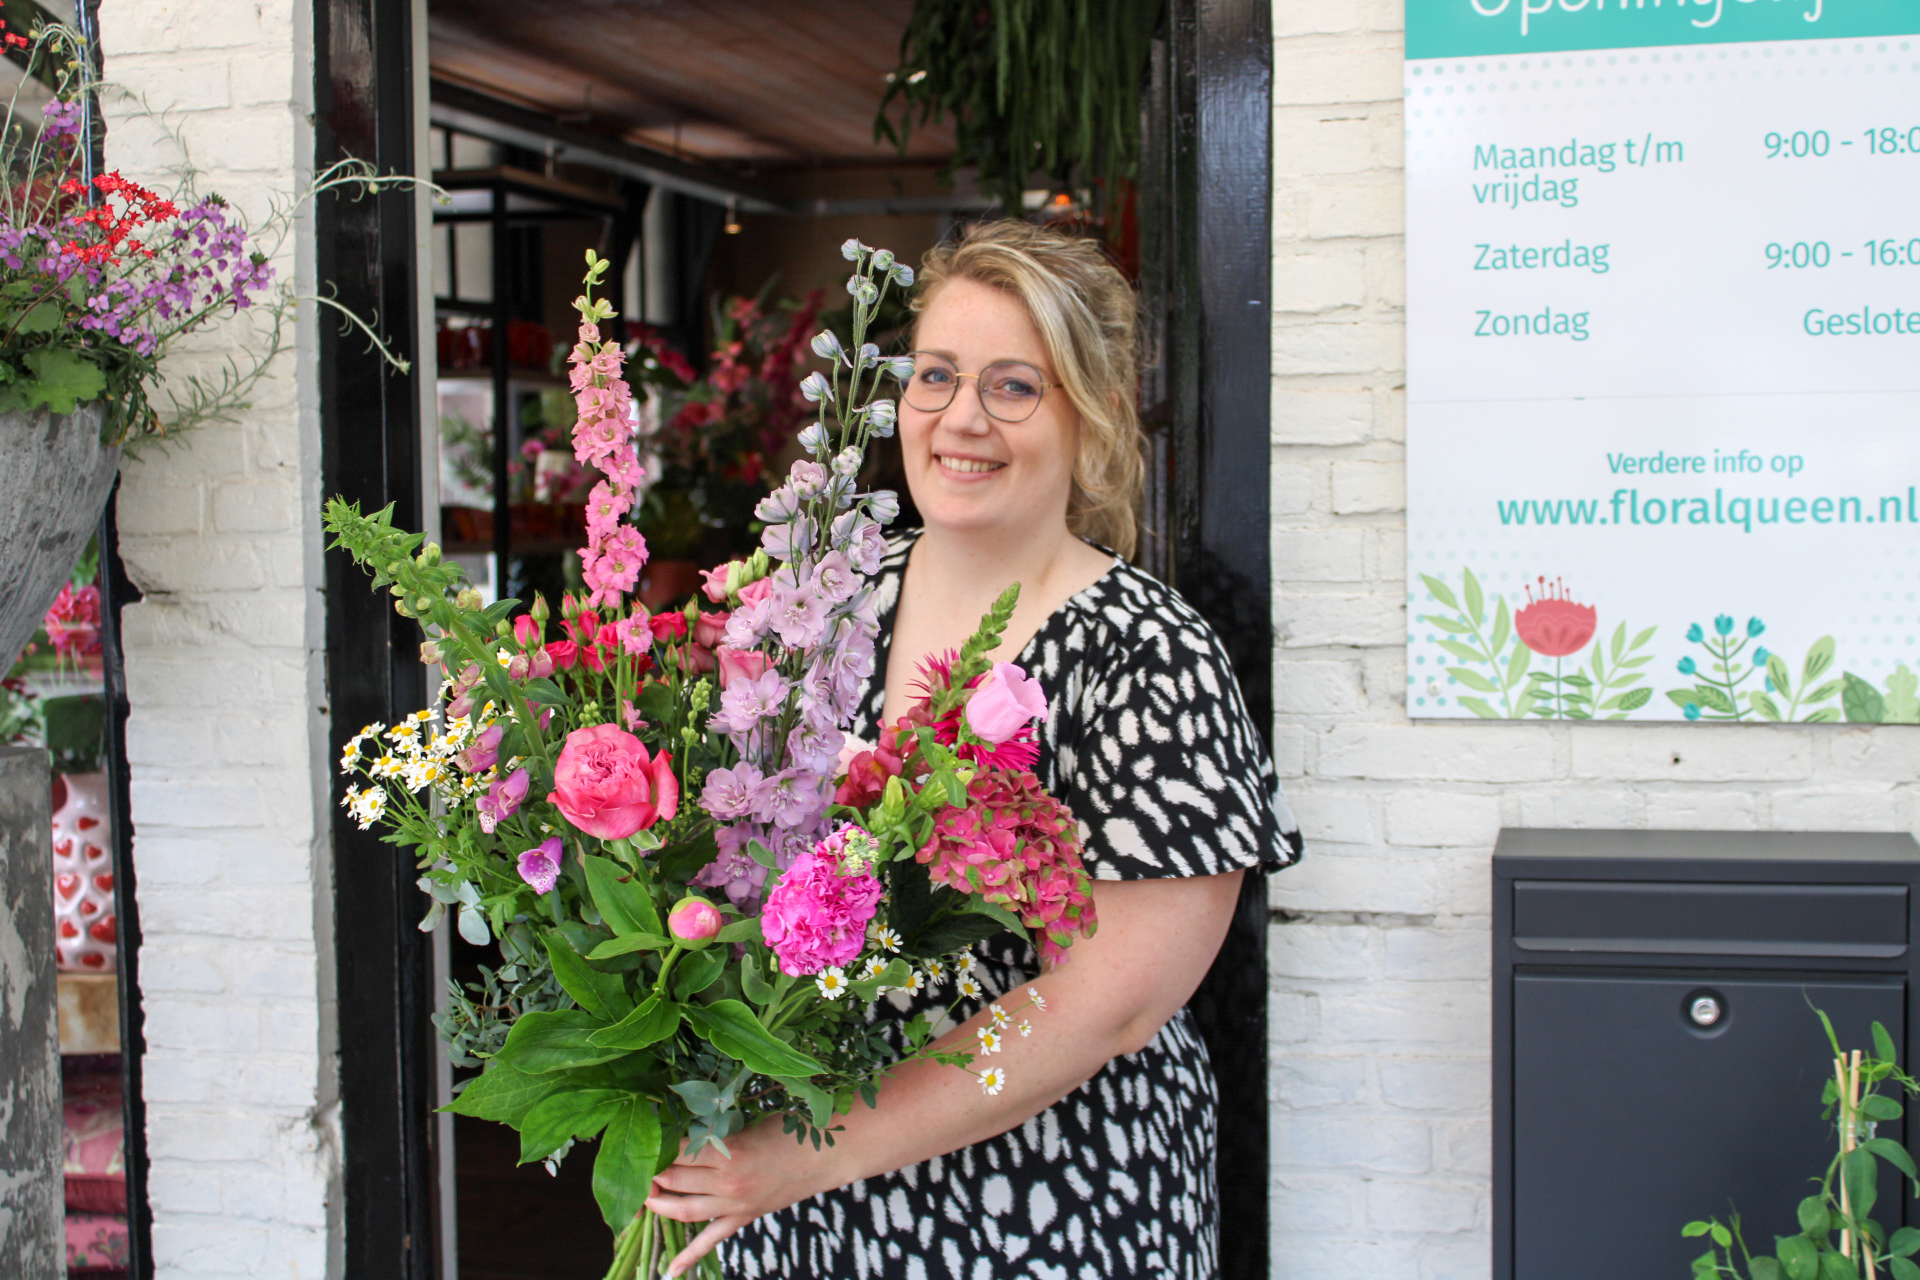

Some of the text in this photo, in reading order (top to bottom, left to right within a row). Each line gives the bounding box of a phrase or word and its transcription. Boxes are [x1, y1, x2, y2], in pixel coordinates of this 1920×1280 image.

[1473, 132, 1684, 173] Maandag t/m
[1764, 130, 1831, 159] 9:00
[1472, 173, 1580, 209] vrijdag
[1473, 239, 1611, 274] Zaterdag
[1765, 241, 1831, 269] 9:00
[1474, 306, 1590, 341] Zondag
[1606, 449, 1805, 478] Verdere info op
[1497, 485, 1920, 534] www.floralqueen.nl
